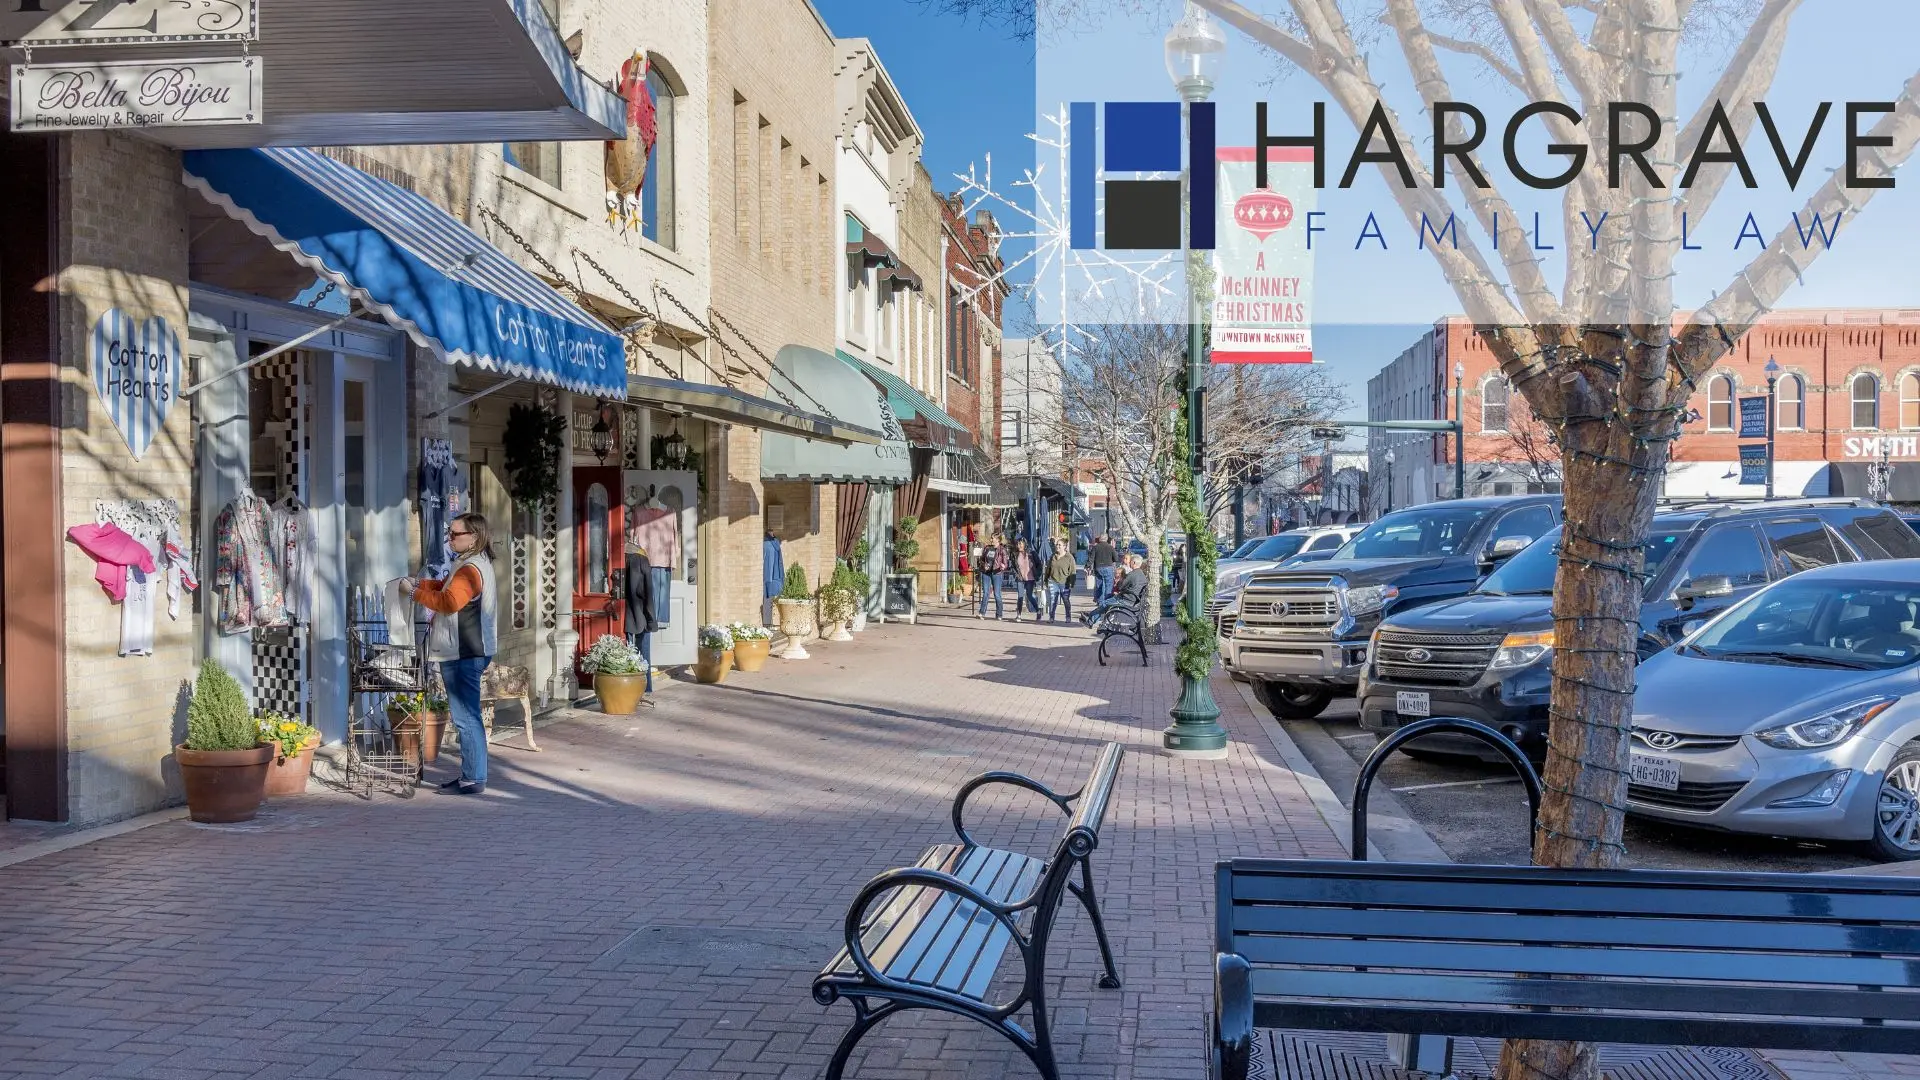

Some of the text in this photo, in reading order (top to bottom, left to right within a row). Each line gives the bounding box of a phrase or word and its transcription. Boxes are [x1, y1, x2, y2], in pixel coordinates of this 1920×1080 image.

[38, 66, 230, 121] Bella Bijou
[35, 110, 164, 128] Fine Jewelry & Repair
[1255, 251, 1265, 271] A
[1221, 276, 1300, 297] McKINNEY
[1216, 302, 1304, 322] CHRISTMAS
[494, 303, 607, 370] Cotton Hearts
[1264, 333, 1305, 343] McKINNEY
[108, 340, 168, 373] Cotton
[107, 367, 169, 401] Hearts
[1742, 458, 1766, 466] GOOD
[1743, 466, 1767, 474] TIMES
[1644, 758, 1664, 766] TEXAS
